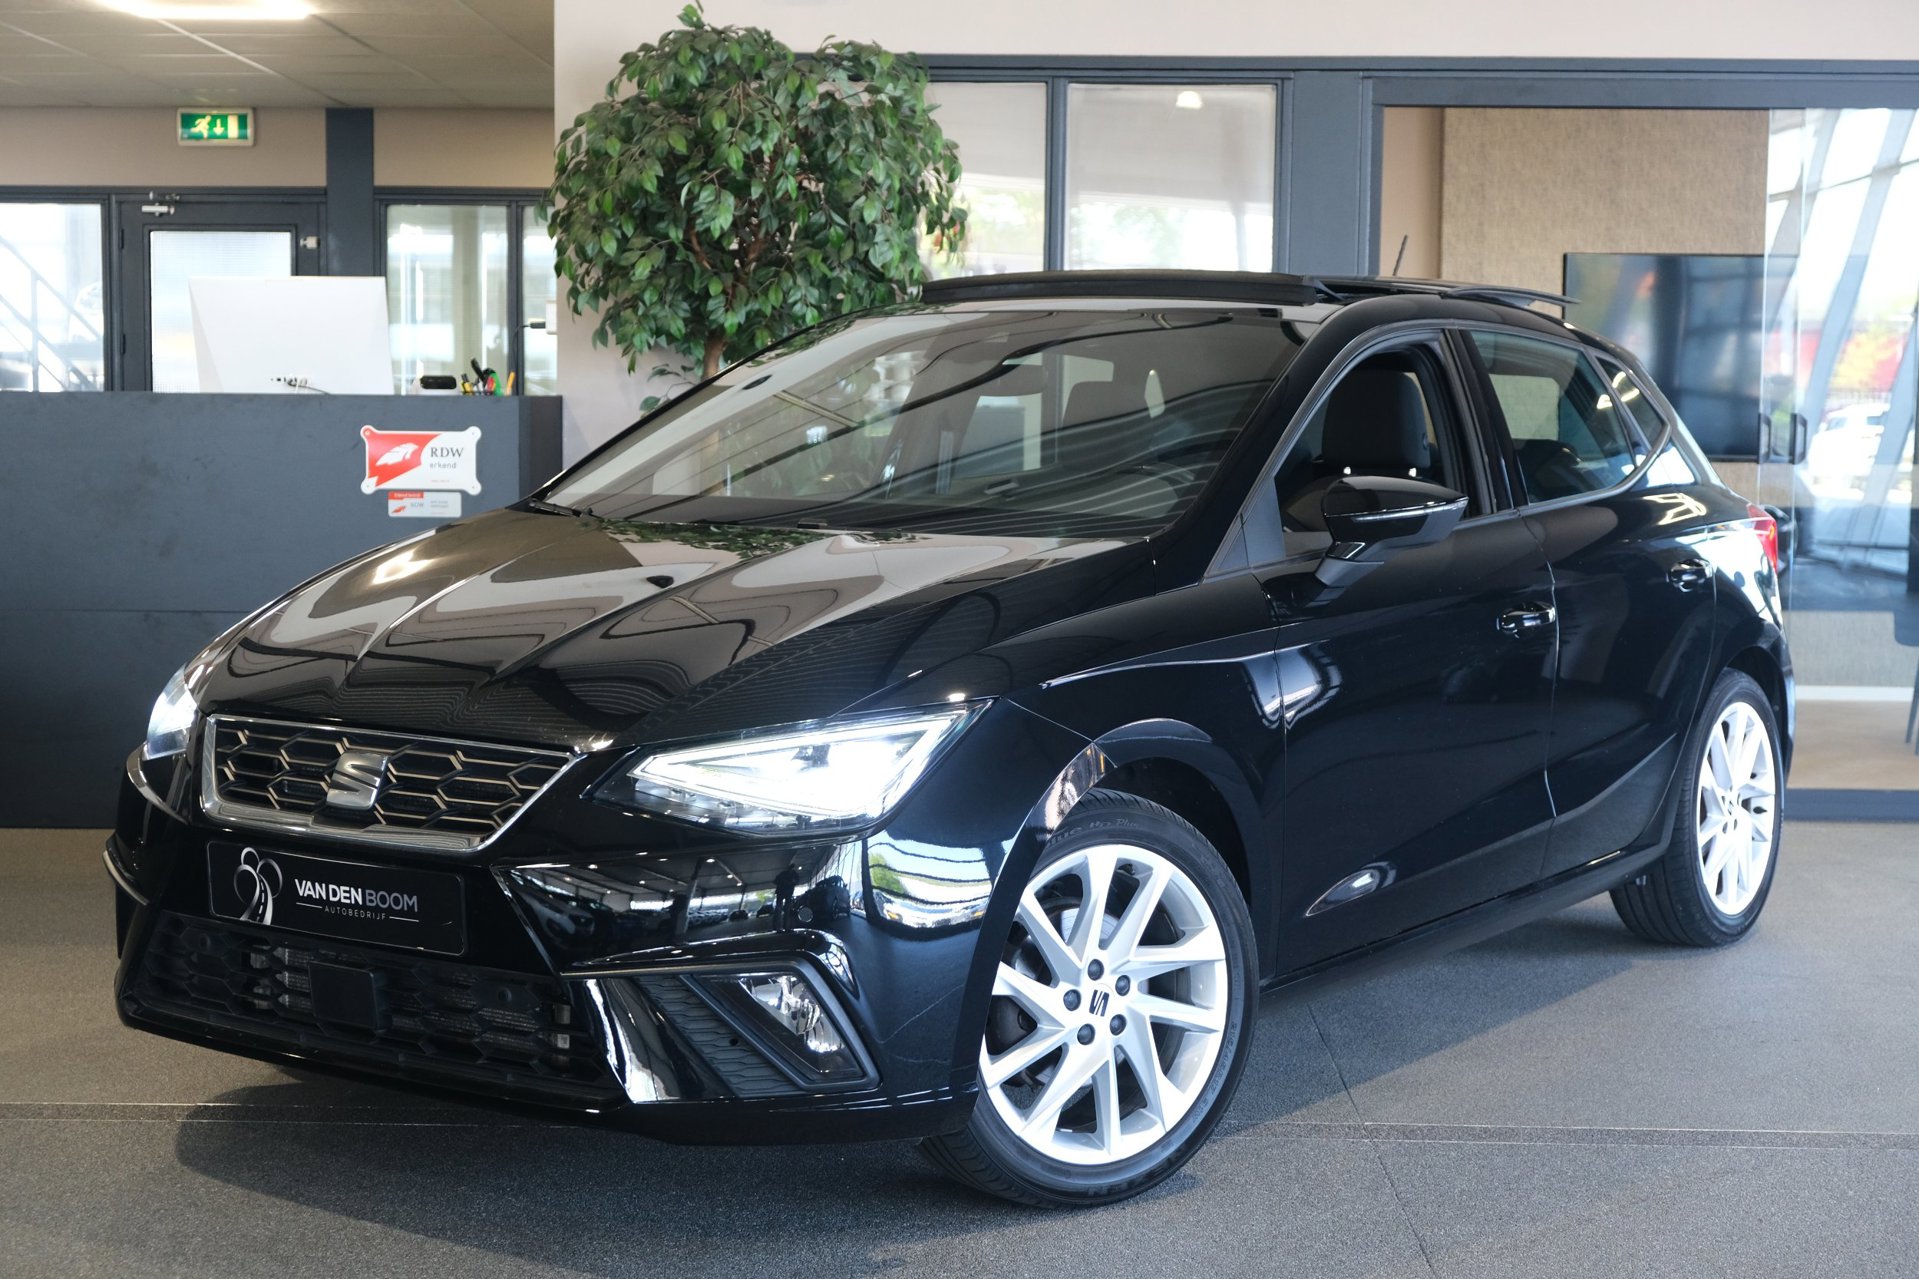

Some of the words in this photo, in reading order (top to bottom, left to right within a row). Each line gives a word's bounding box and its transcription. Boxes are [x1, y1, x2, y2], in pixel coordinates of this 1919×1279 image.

[430, 447, 464, 458] RDW
[429, 461, 457, 469] erkend
[294, 878, 327, 900] VAN
[329, 884, 363, 905] DEN
[365, 889, 418, 912] BOOM
[324, 906, 387, 921] AUTOBEDRIJF
